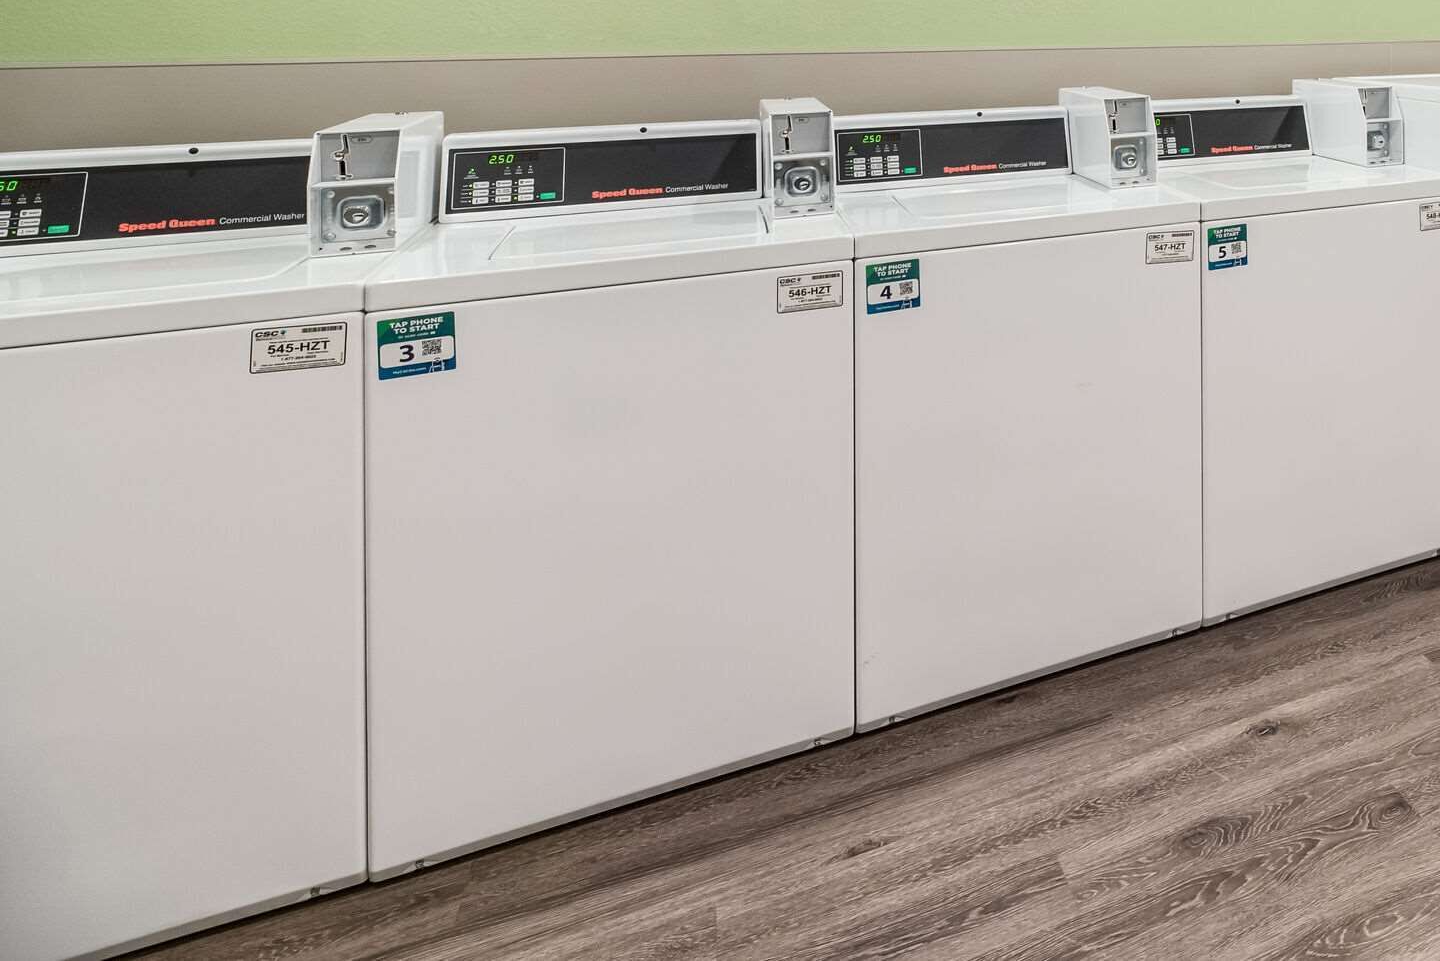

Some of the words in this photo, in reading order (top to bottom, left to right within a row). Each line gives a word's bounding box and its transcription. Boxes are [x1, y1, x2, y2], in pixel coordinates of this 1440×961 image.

[591, 188, 627, 199] Speed
[628, 186, 663, 196] Queen
[665, 184, 704, 194] Commercial
[704, 182, 729, 190] Washer
[118, 220, 166, 233] Speed
[168, 217, 216, 228] Queen
[219, 214, 272, 225] Commercial
[273, 212, 305, 221] Washer
[1154, 242, 1187, 251] 547-HZT
[1218, 246, 1227, 259] 5
[887, 268, 909, 276] START
[888, 262, 912, 270] PHONE
[788, 285, 833, 298] 546-HZT
[880, 285, 893, 300] 4
[389, 321, 409, 329] TAP
[410, 316, 444, 326] PHONE
[393, 327, 407, 335] TO
[409, 323, 440, 333] START
[255, 330, 279, 338] CSC
[267, 340, 331, 355] 545-HZT
[399, 344, 415, 363] 3
